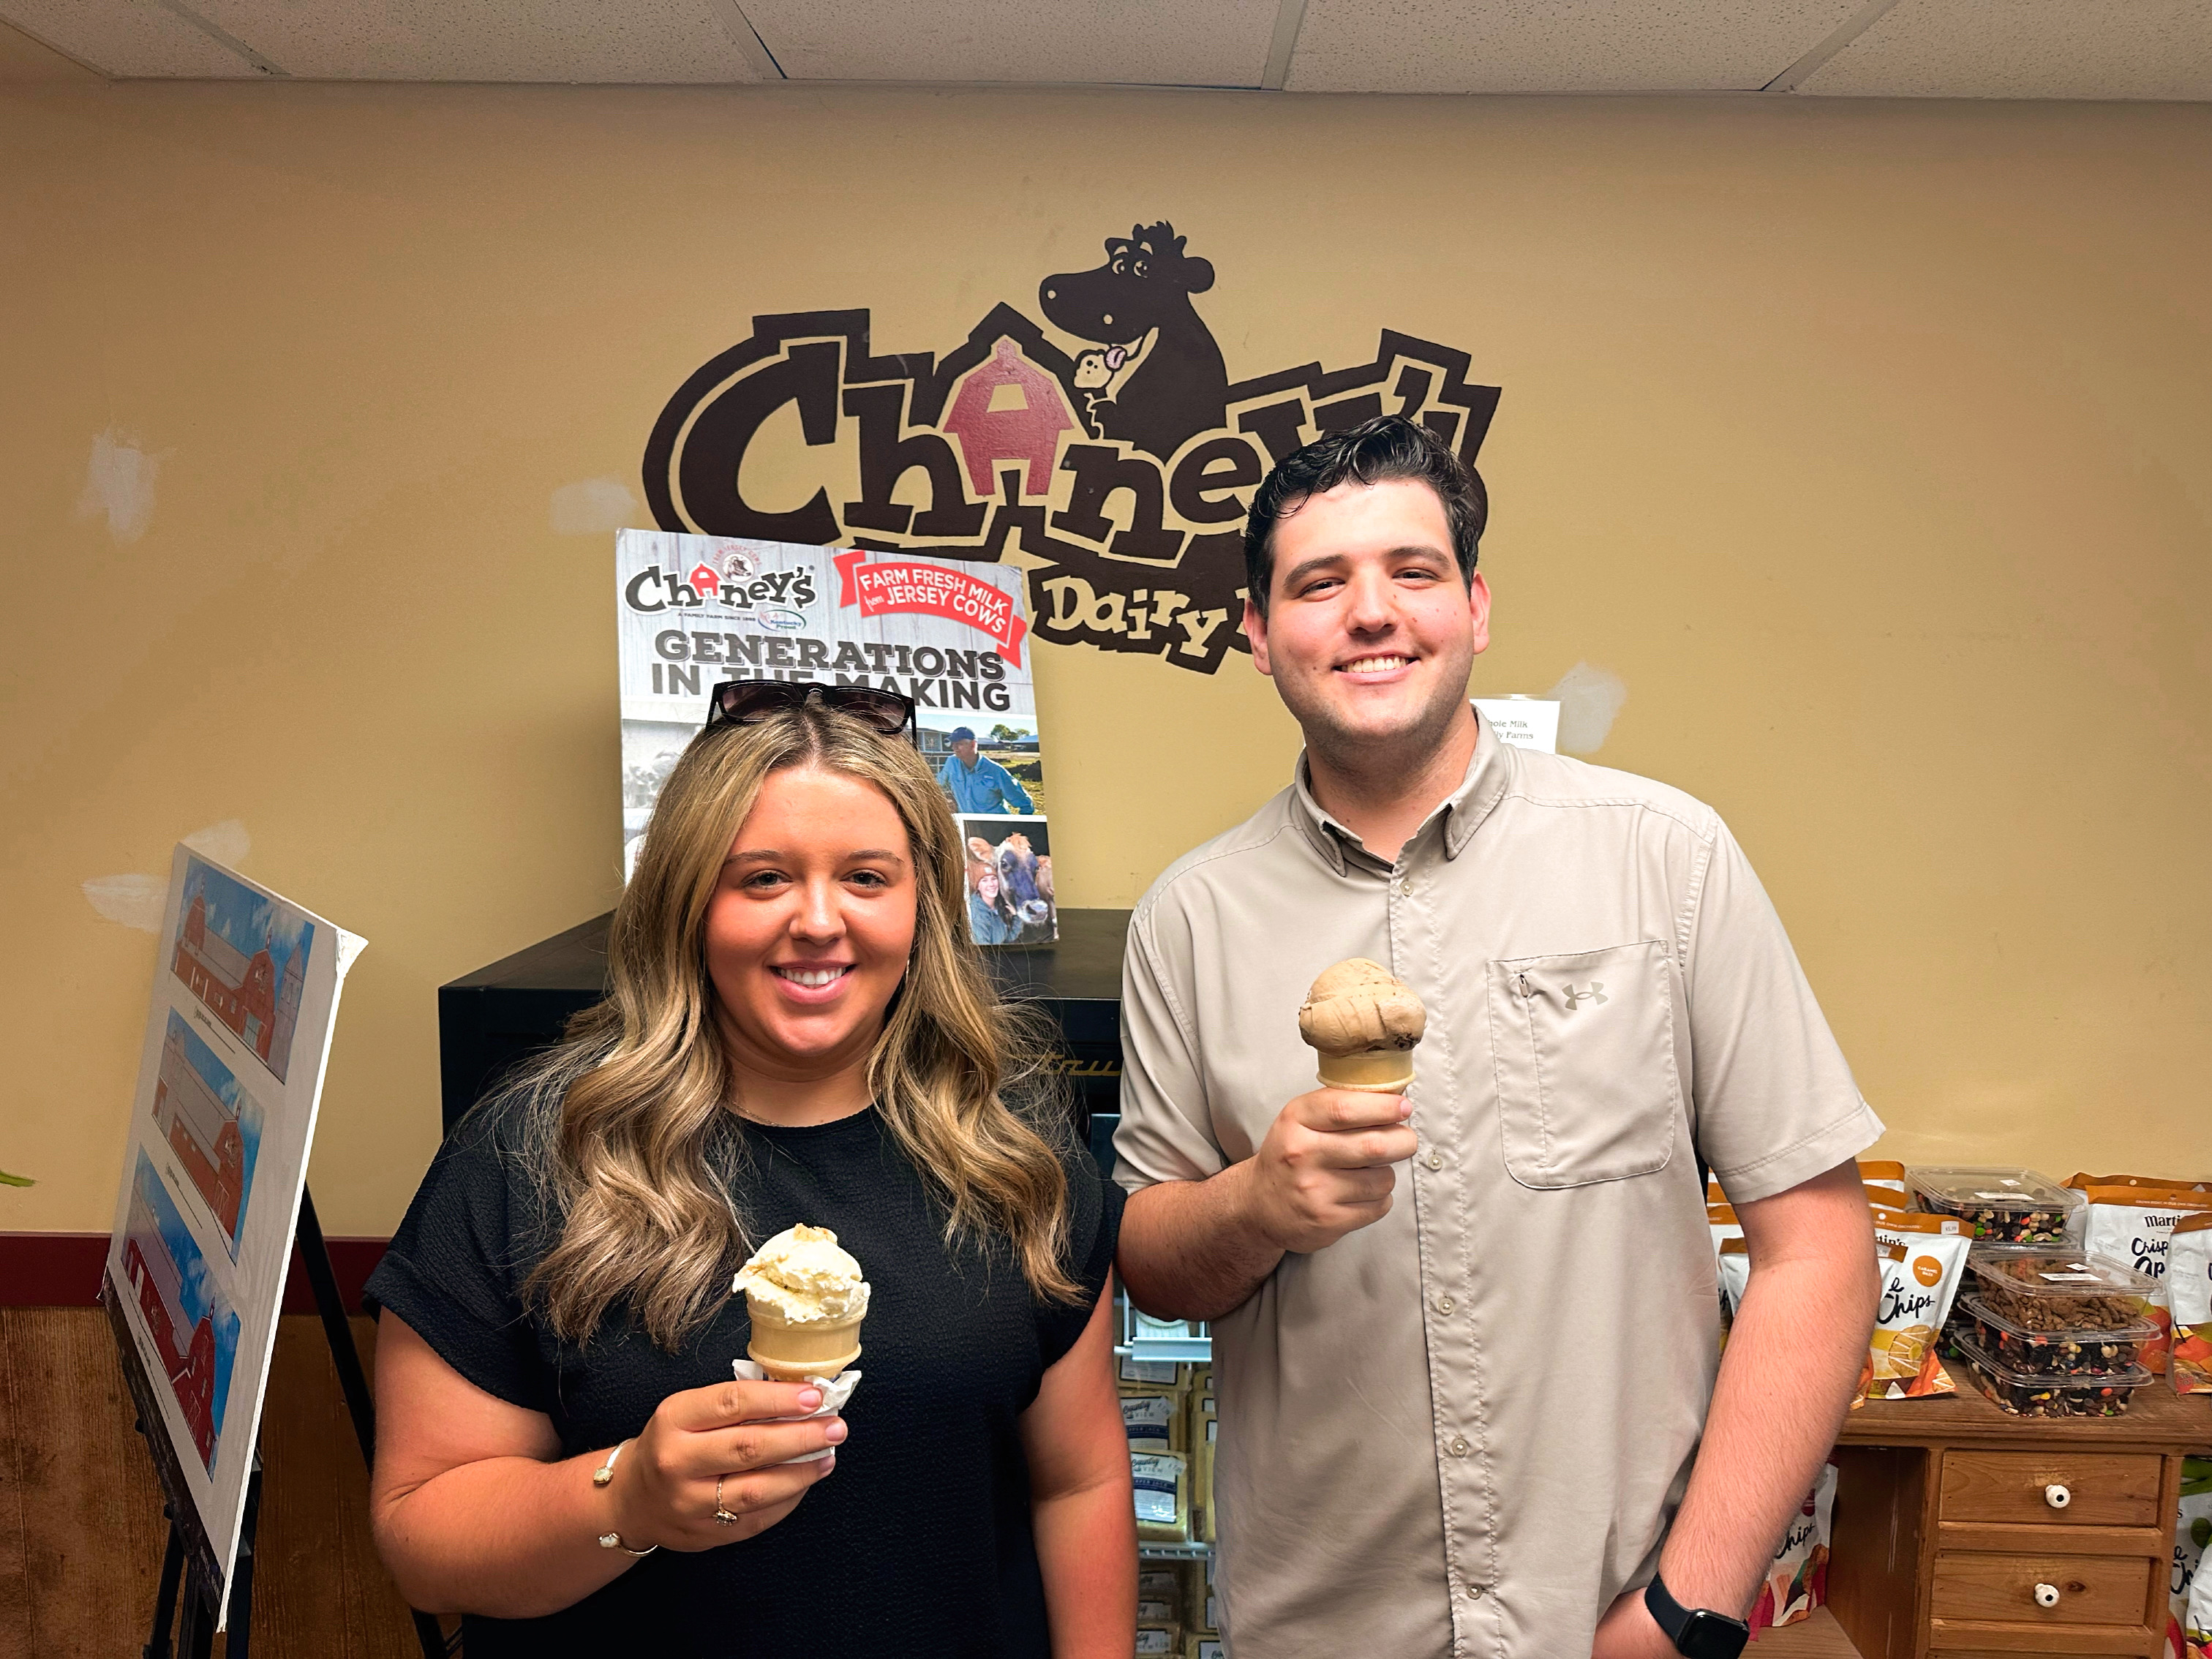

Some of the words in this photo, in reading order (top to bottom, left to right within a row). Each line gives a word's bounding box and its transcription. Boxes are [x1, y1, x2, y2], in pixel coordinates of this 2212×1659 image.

[625, 563, 816, 612] Chaney's
[859, 568, 909, 591] FARM
[911, 569, 966, 594] FRESH
[968, 583, 1009, 616] MILK
[770, 619, 802, 628] Kentucky
[863, 594, 884, 612] from
[887, 584, 950, 607] JERSEY
[953, 594, 1007, 633] COWS
[1042, 575, 1228, 658] Dairy
[655, 630, 1007, 682] GENERATIONS
[652, 663, 701, 696] IN
[1506, 731, 1534, 740] Farms
[1510, 721, 1528, 729] Milk
[2144, 1215, 2181, 1227] Marti
[2131, 1237, 2169, 1257] Crisp
